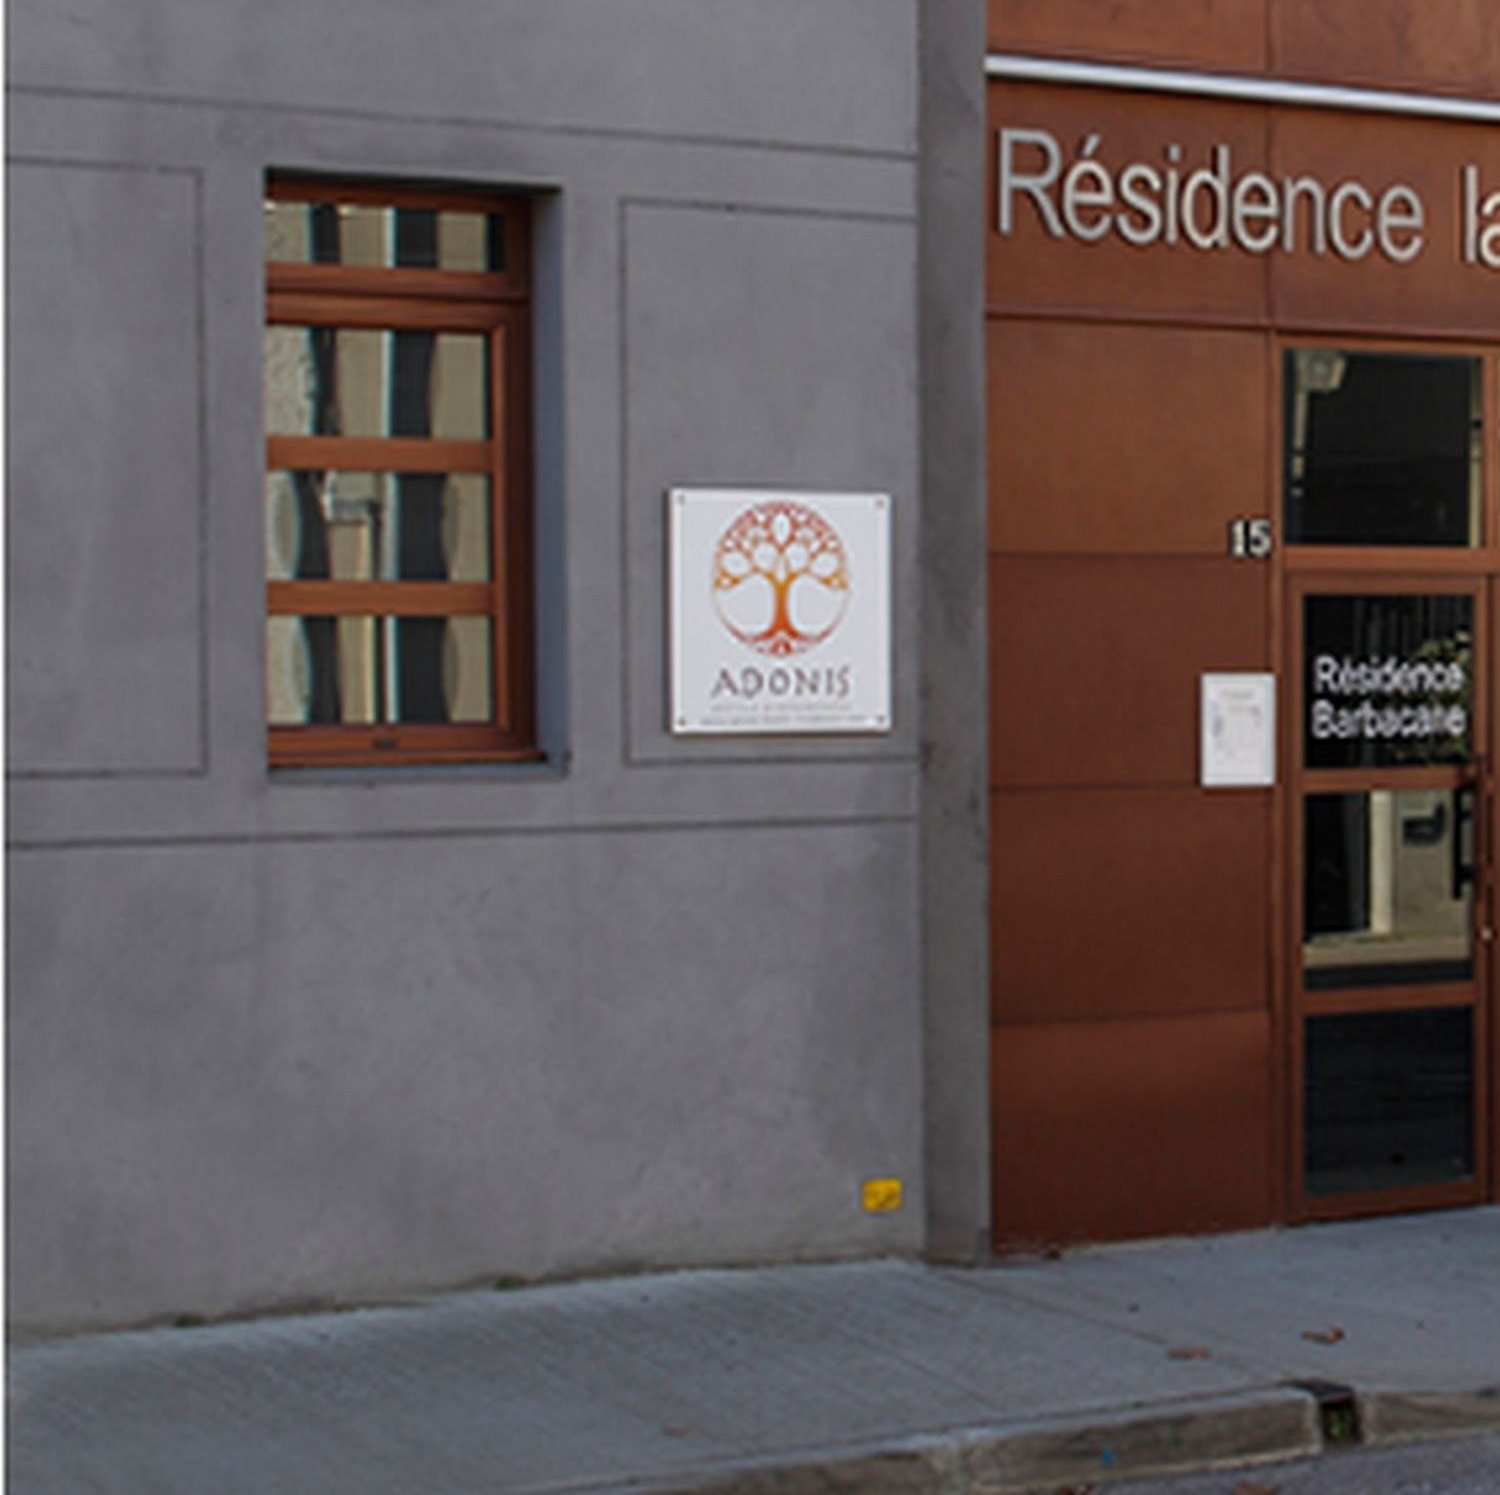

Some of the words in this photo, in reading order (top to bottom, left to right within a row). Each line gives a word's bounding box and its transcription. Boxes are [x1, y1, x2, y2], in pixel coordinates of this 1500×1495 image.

[998, 125, 1425, 263] Résidence
[1228, 518, 1273, 557] 15
[710, 666, 851, 700] ADONIS
